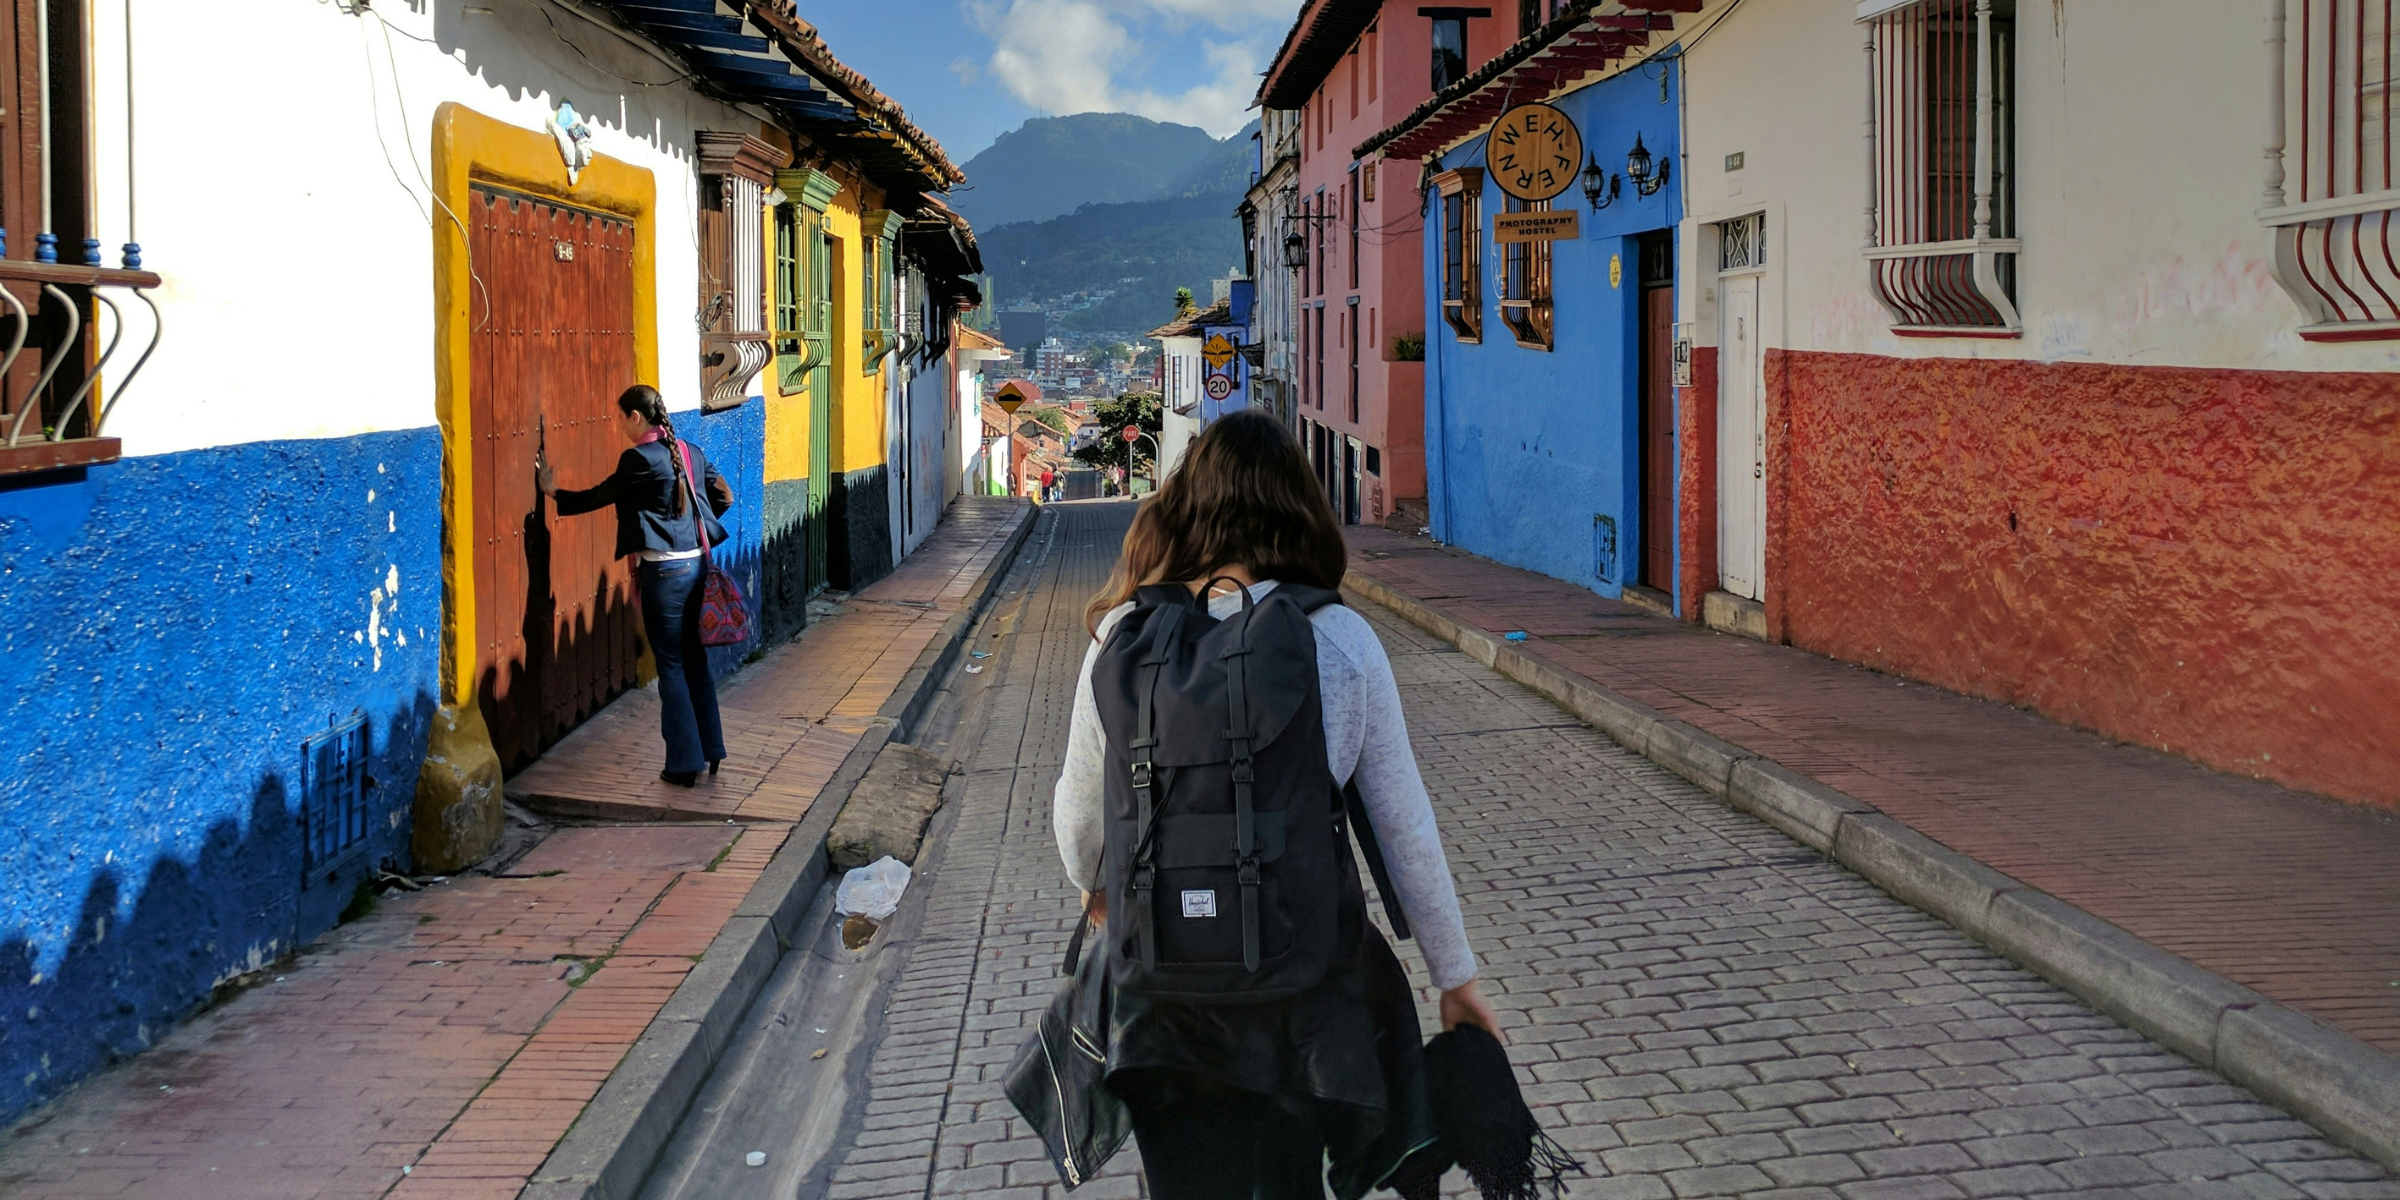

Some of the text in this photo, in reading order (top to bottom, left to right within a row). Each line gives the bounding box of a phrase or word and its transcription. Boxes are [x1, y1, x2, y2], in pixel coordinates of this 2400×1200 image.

[1499, 217, 1573, 228] PHOTOGRAPHY
[1518, 227, 1556, 236] HOSTEL
[558, 244, 574, 261] 9-45
[1209, 380, 1227, 393] 20
